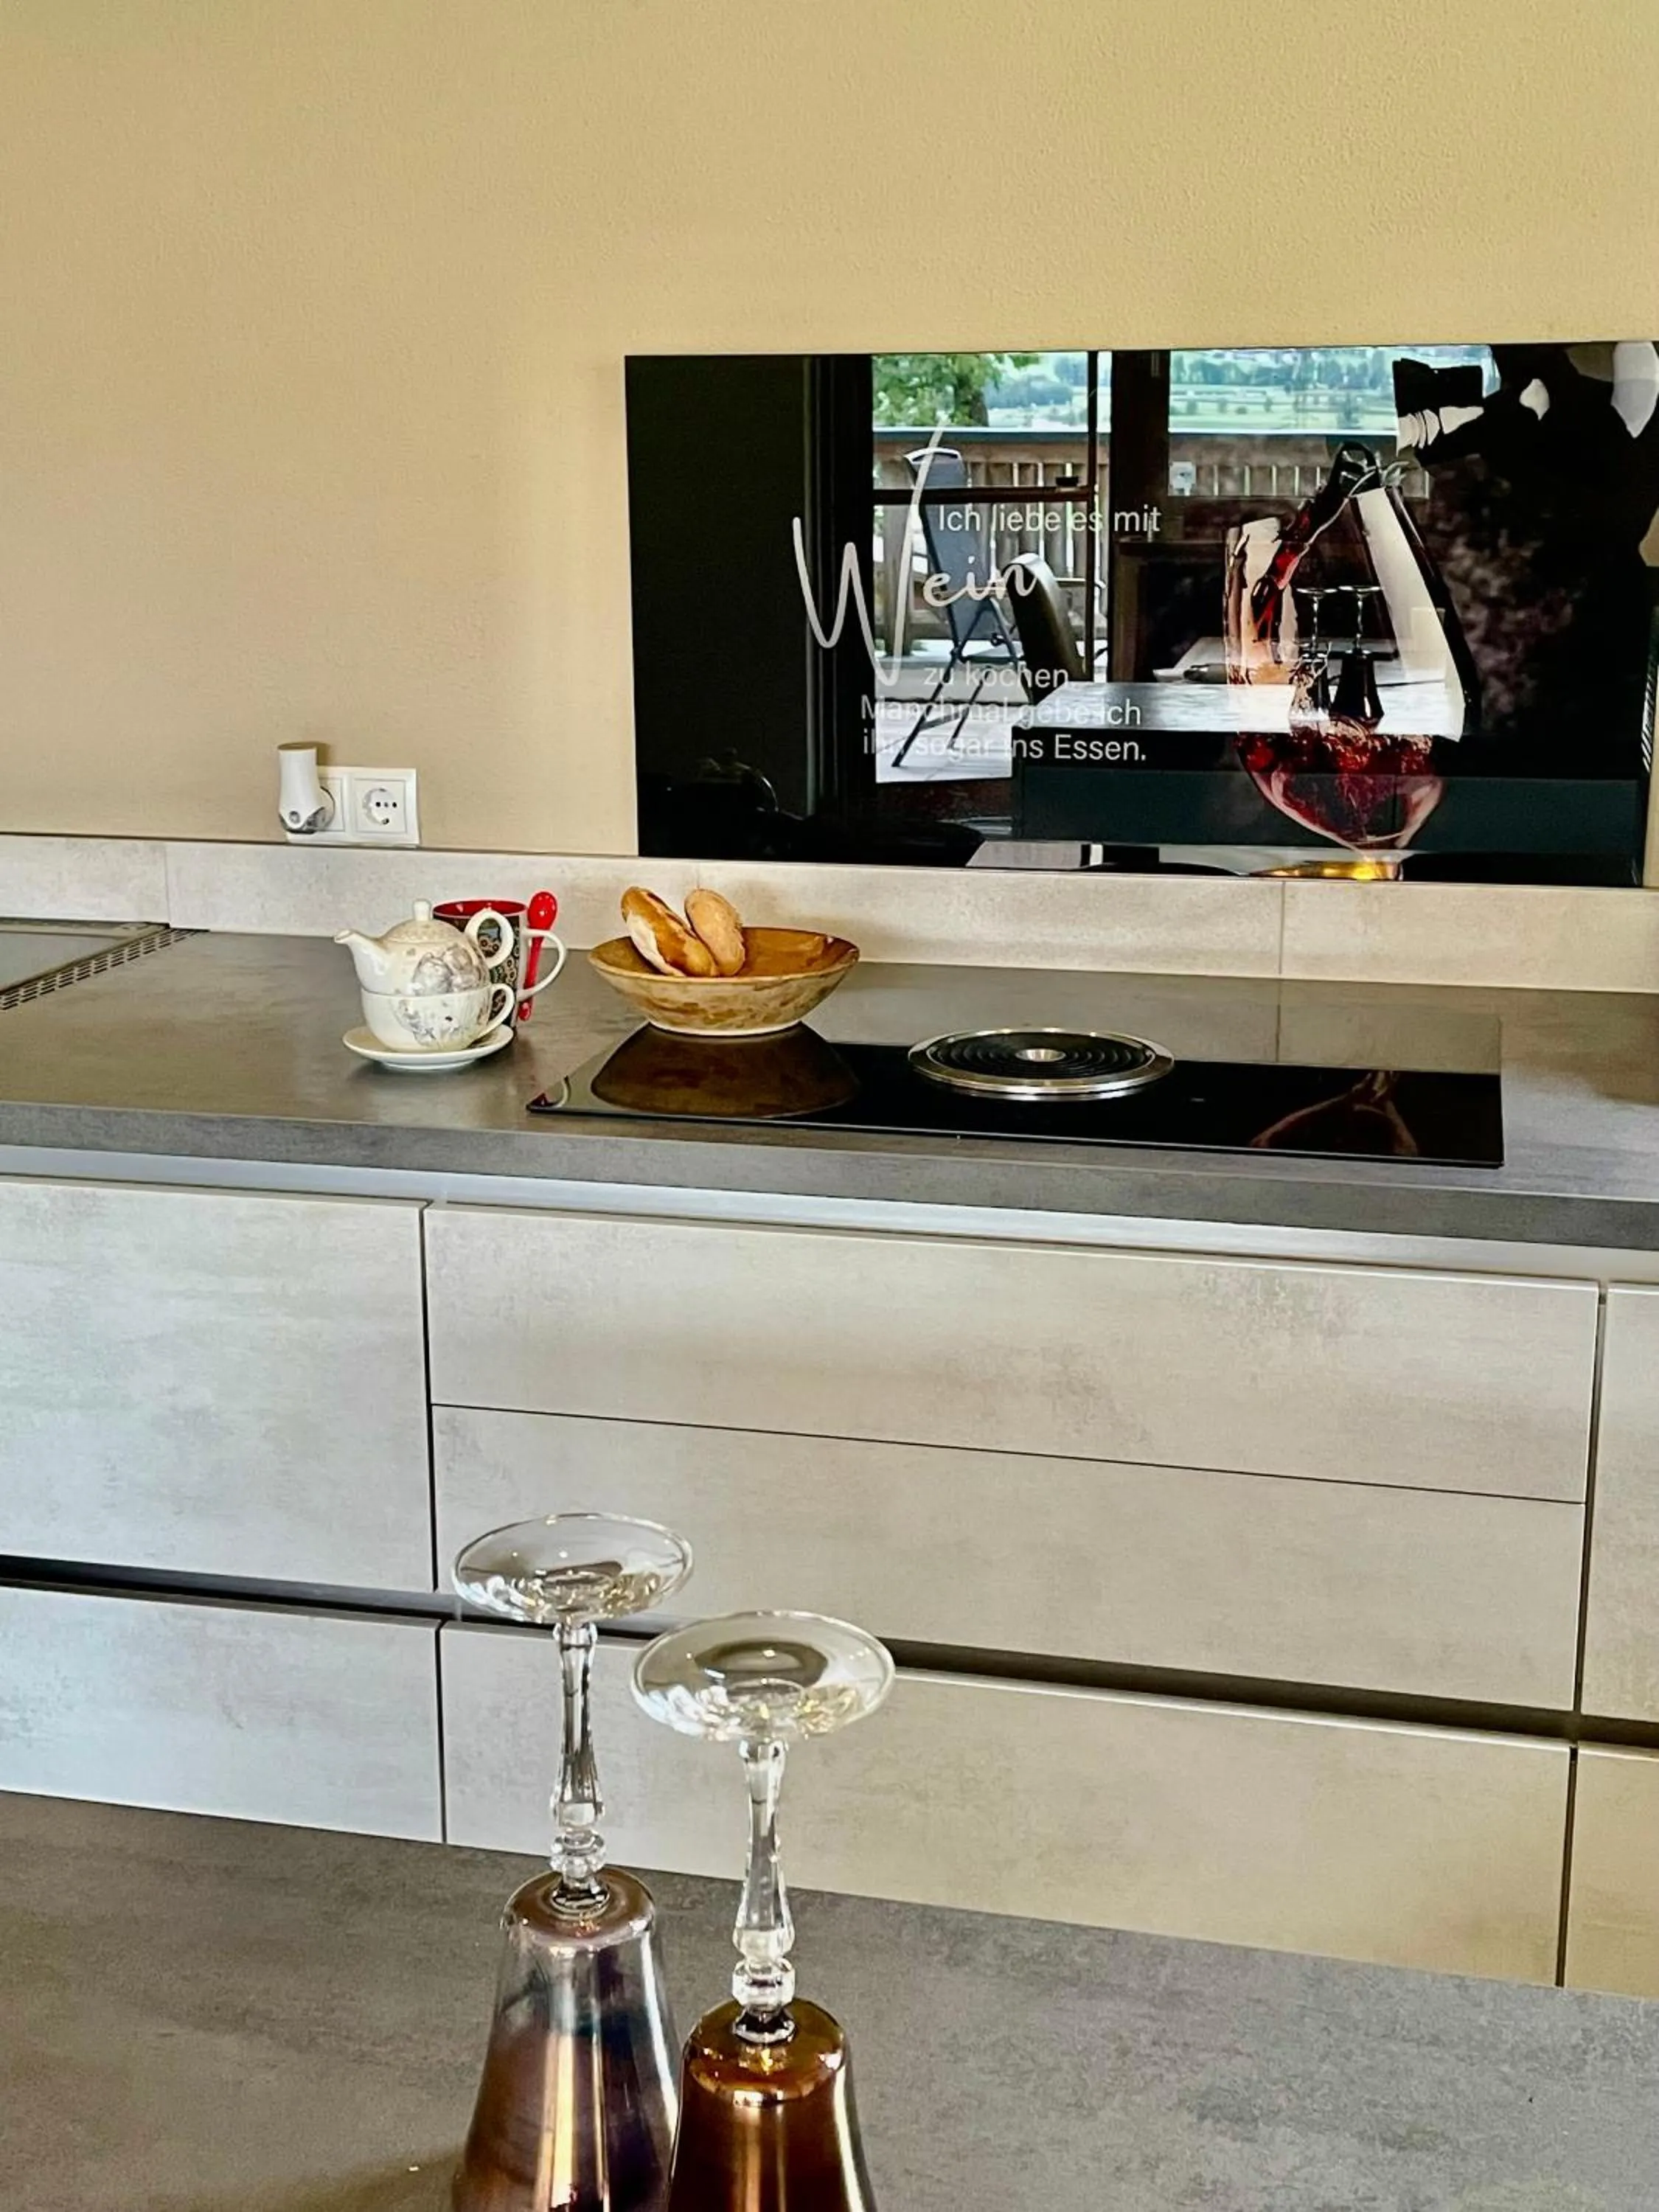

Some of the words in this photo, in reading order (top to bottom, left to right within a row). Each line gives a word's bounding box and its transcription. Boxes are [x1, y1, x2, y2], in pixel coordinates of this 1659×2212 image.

[939, 504, 981, 532] Ich
[991, 504, 1062, 532] liebe
[1071, 509, 1104, 532] es
[1113, 504, 1162, 532] mit
[792, 394, 1041, 687] Wein
[923, 666, 954, 686] zu
[860, 693, 1008, 723] Manchmal
[1018, 696, 1089, 730] gebe
[915, 736, 993, 762] sogar
[1005, 730, 1044, 759] ins
[1054, 733, 1147, 761] Essen.
